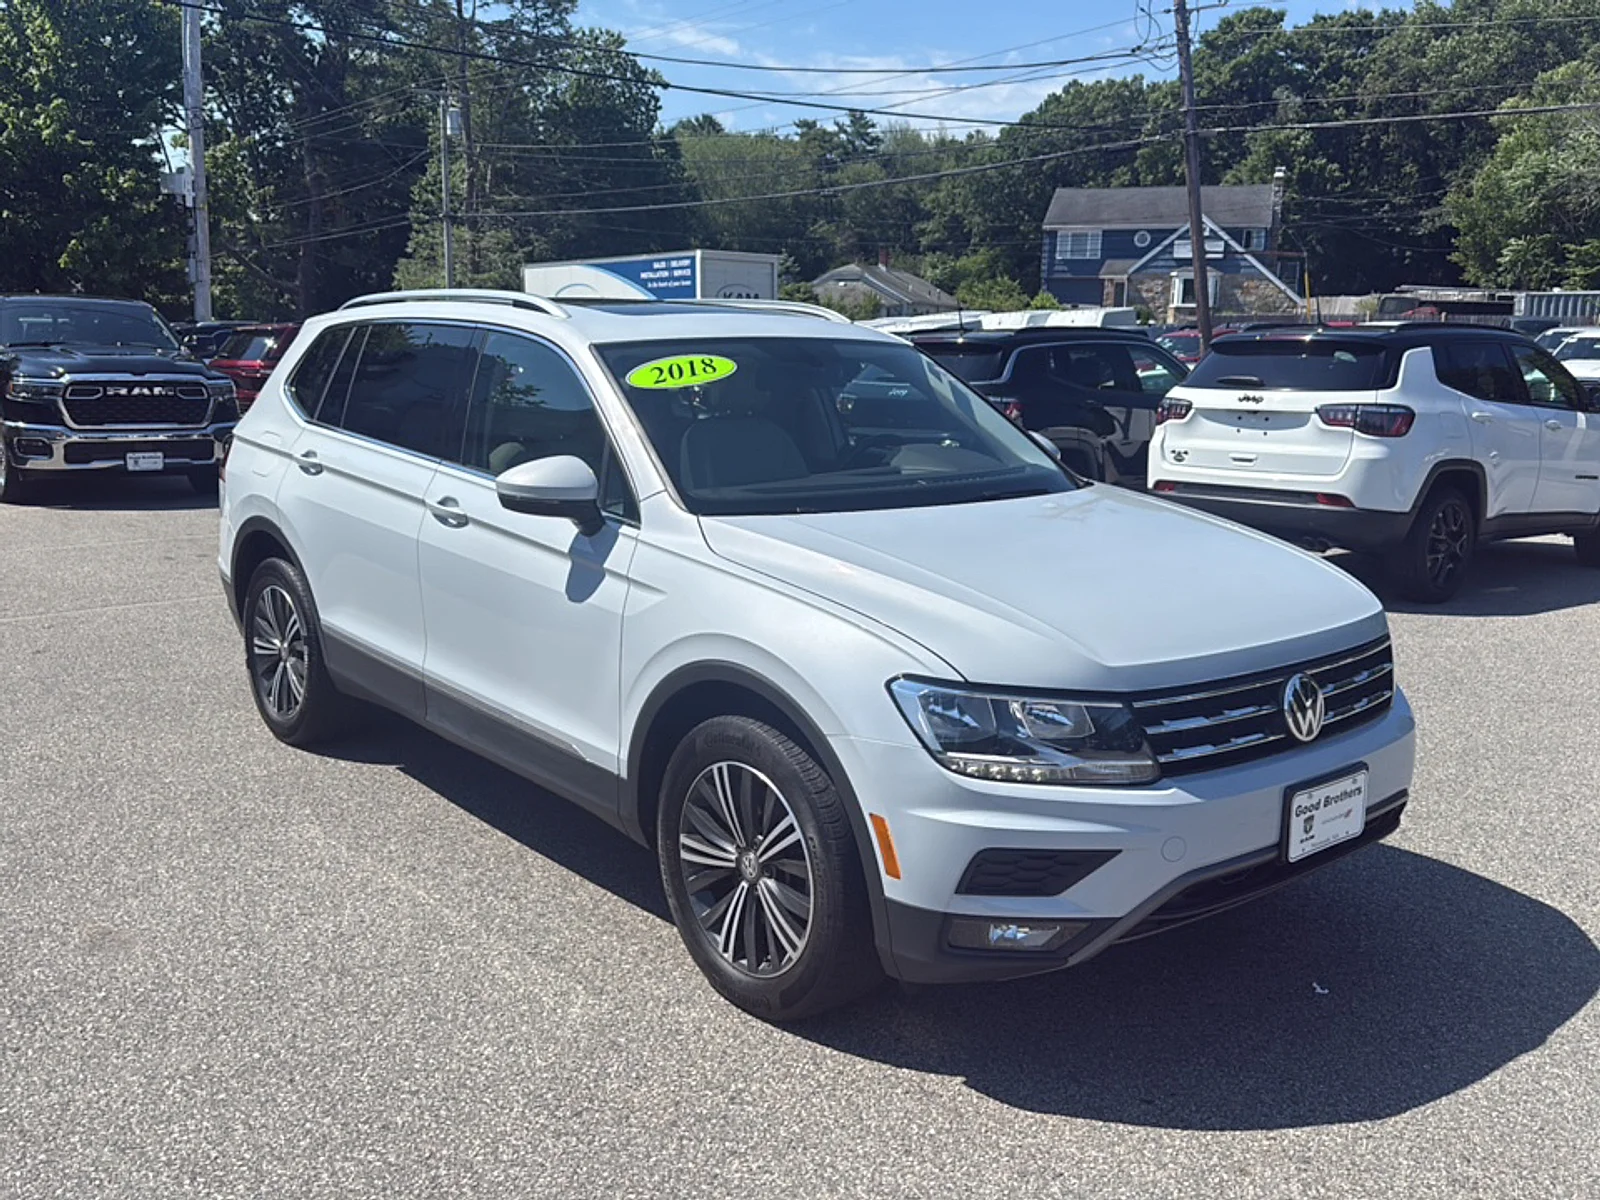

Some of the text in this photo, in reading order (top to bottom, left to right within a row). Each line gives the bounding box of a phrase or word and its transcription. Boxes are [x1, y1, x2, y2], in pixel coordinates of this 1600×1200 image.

[670, 259, 691, 268] DELIVERY
[640, 269, 691, 279] INSTALLATION SERVICE
[650, 358, 717, 385] 2018
[106, 386, 175, 396] RAM
[1238, 393, 1265, 405] Jeep
[1295, 798, 1321, 818] Good
[1323, 787, 1363, 808] Brothers
